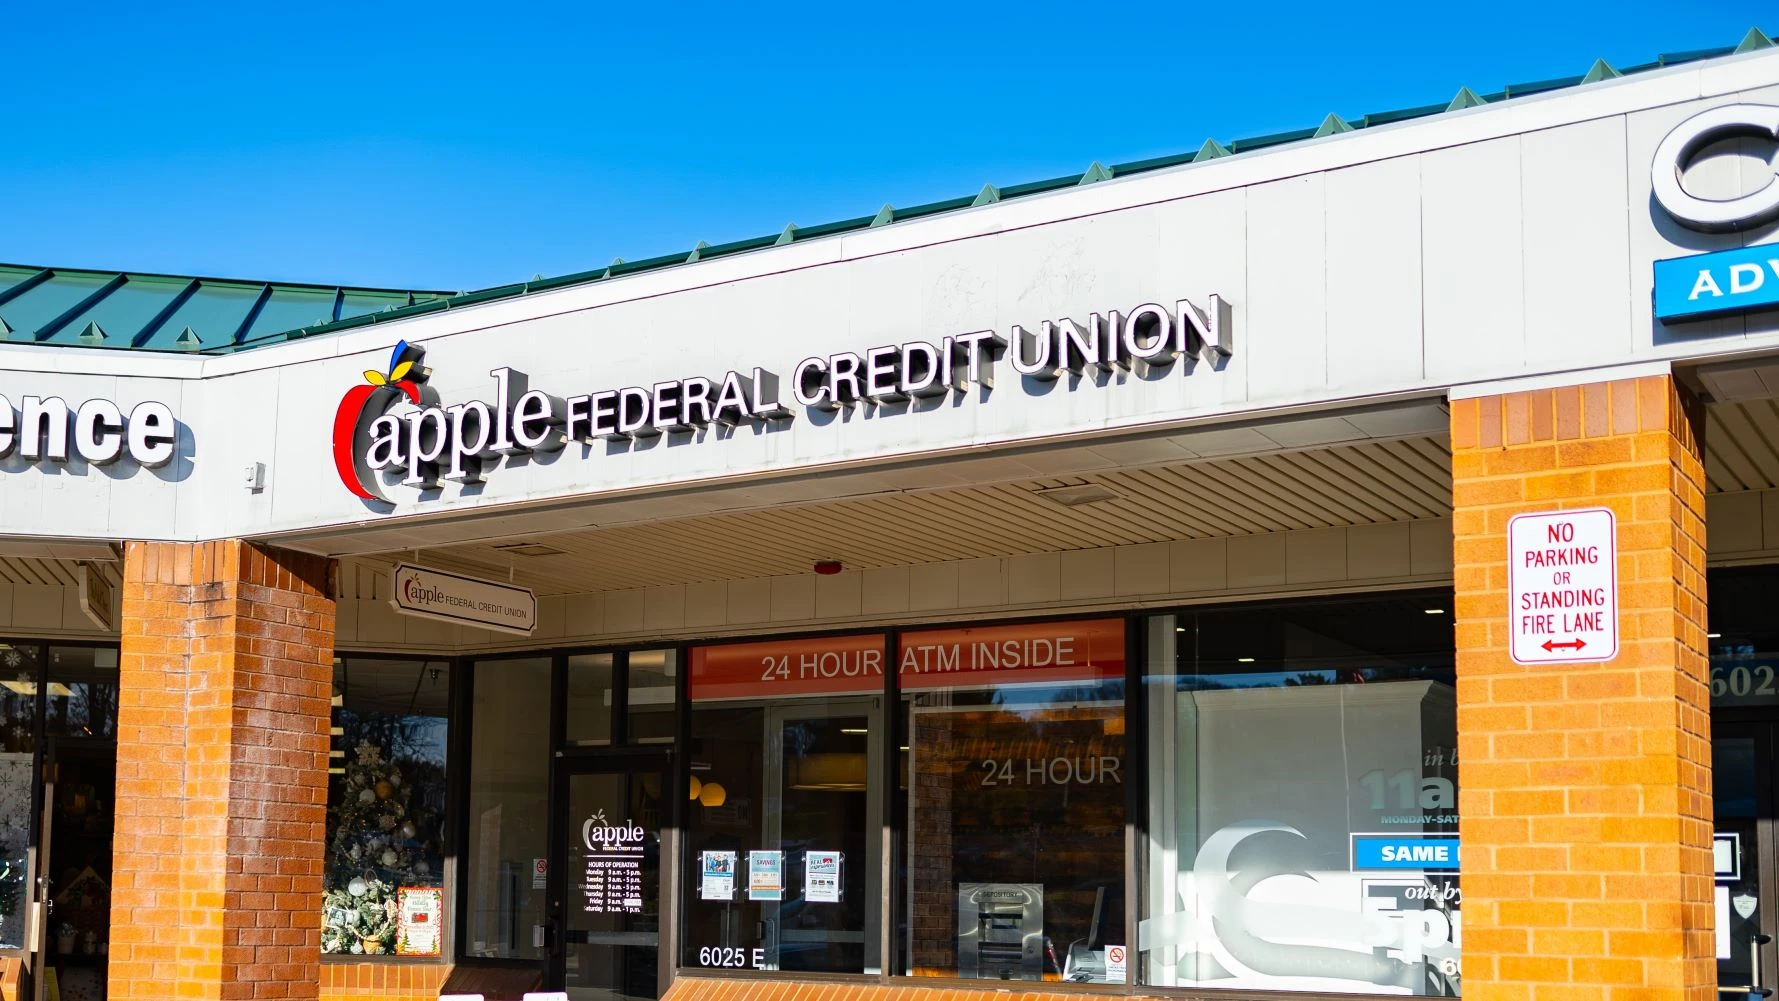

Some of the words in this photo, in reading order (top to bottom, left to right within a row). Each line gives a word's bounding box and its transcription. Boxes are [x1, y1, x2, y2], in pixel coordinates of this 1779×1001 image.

[366, 367, 551, 484] apple
[566, 367, 779, 441] FEDERAL
[793, 330, 998, 406] CREDIT
[1011, 294, 1220, 375] UNION
[1548, 522, 1574, 543] NO
[1525, 546, 1598, 568] PARKING
[1553, 571, 1571, 585] OR
[410, 585, 445, 605] apple
[445, 596, 477, 610] FEDERAL
[478, 602, 503, 614] CREDIT
[504, 607, 527, 619] UNION
[1521, 588, 1605, 610] STANDING
[1522, 614, 1555, 635] FIRE
[1563, 612, 1604, 633] LANE
[761, 656, 791, 681] 24
[800, 649, 882, 679] HOUR
[900, 644, 960, 674] ATM
[971, 637, 1075, 670] INSIDE
[1711, 665, 1779, 697] 602
[1424, 749, 1444, 767] in
[981, 758, 1015, 786] 24
[1027, 756, 1120, 785] HOUR
[592, 819, 644, 847] apple
[1381, 845, 1449, 862] SAME
[586, 869, 604, 877] Monday
[584, 891, 603, 899] Thursday
[1404, 884, 1439, 900] out
[1443, 881, 1463, 904] by
[1362, 896, 1461, 963] 5p
[700, 946, 745, 967] 6025
[752, 948, 765, 967] E
